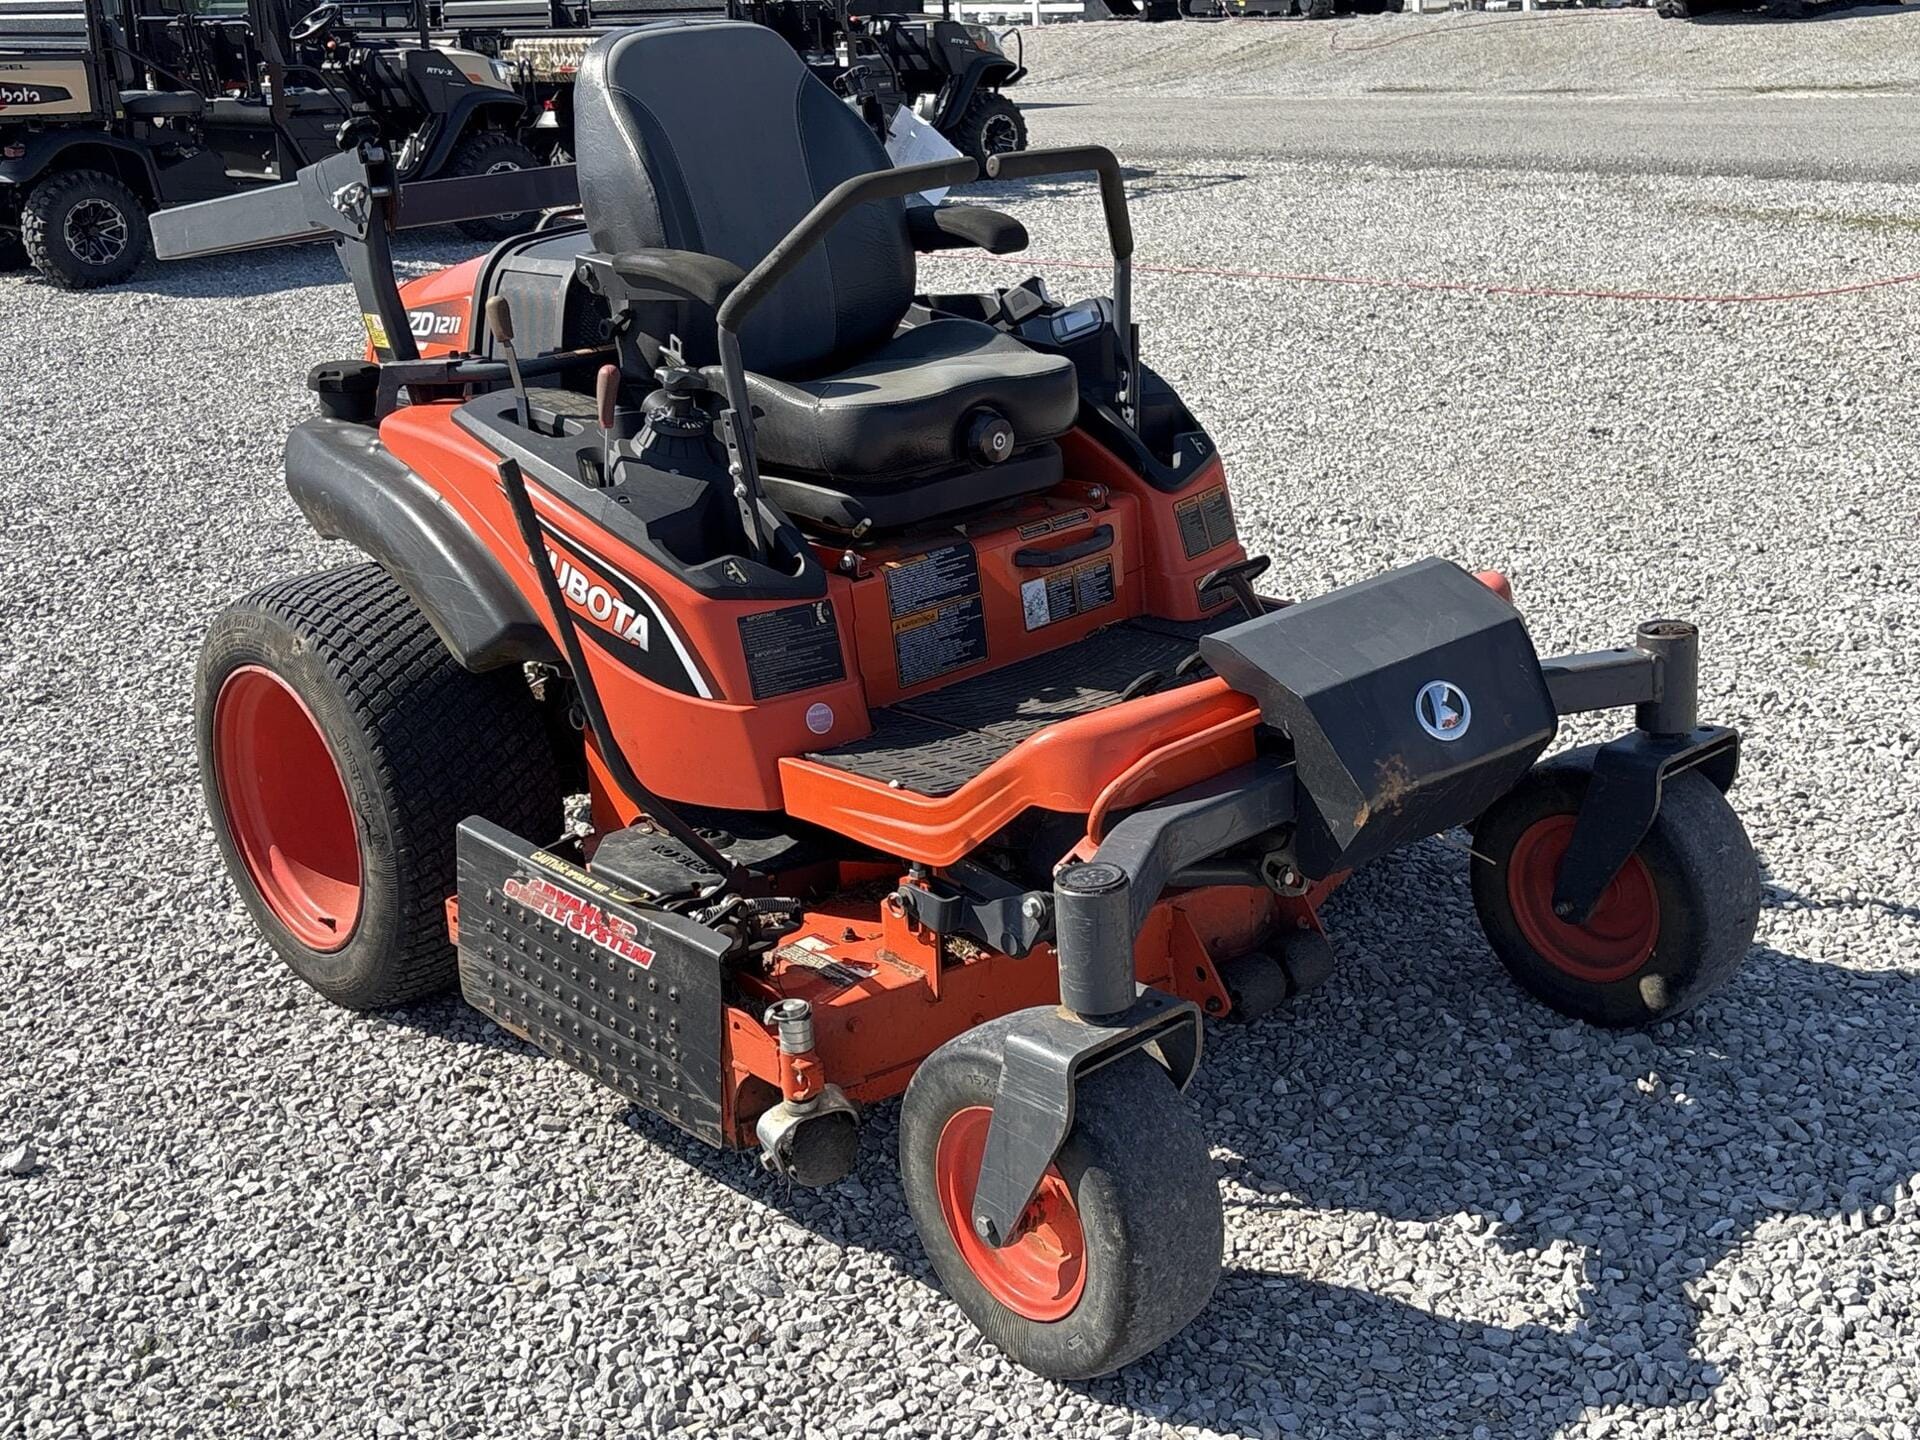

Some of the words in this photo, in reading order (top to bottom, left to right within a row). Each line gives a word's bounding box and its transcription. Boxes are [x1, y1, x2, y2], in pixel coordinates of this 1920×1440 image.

[426, 66, 454, 77] RTV-X
[409, 311, 435, 337] ZD
[434, 315, 462, 334] 1211
[568, 912, 654, 968] SYSTEM
